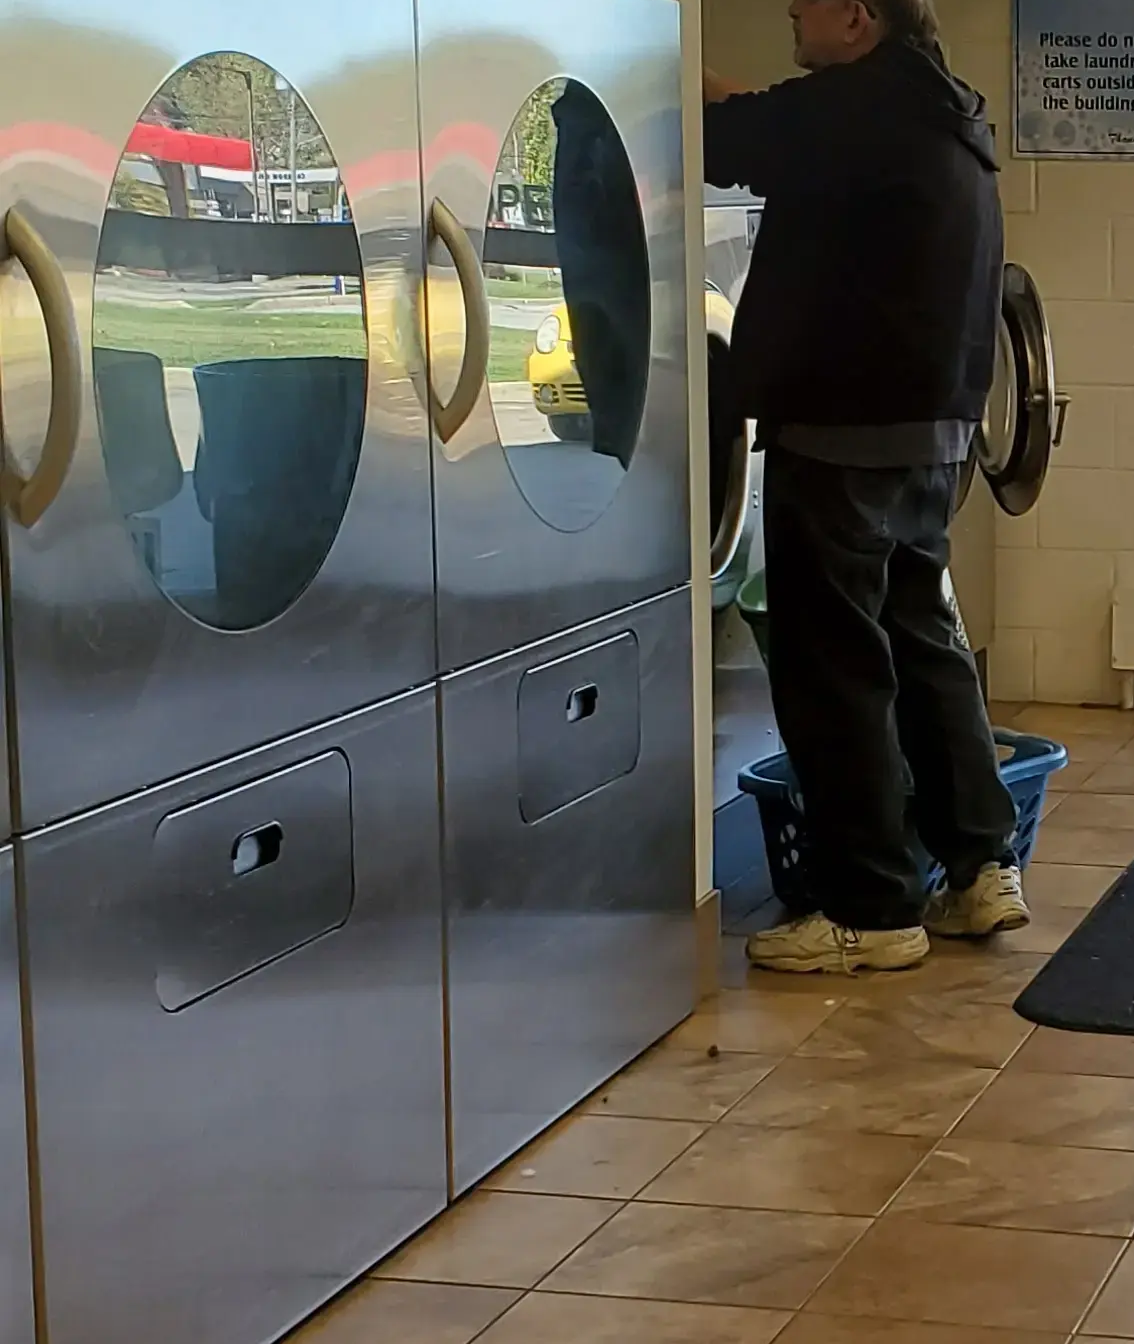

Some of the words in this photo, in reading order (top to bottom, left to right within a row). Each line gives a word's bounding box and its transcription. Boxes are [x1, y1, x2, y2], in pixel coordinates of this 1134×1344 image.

[1039, 32, 1091, 48] Please
[1098, 32, 1117, 48] do
[1044, 53, 1078, 68] take
[1042, 75, 1081, 89] carts
[1042, 95, 1069, 110] the
